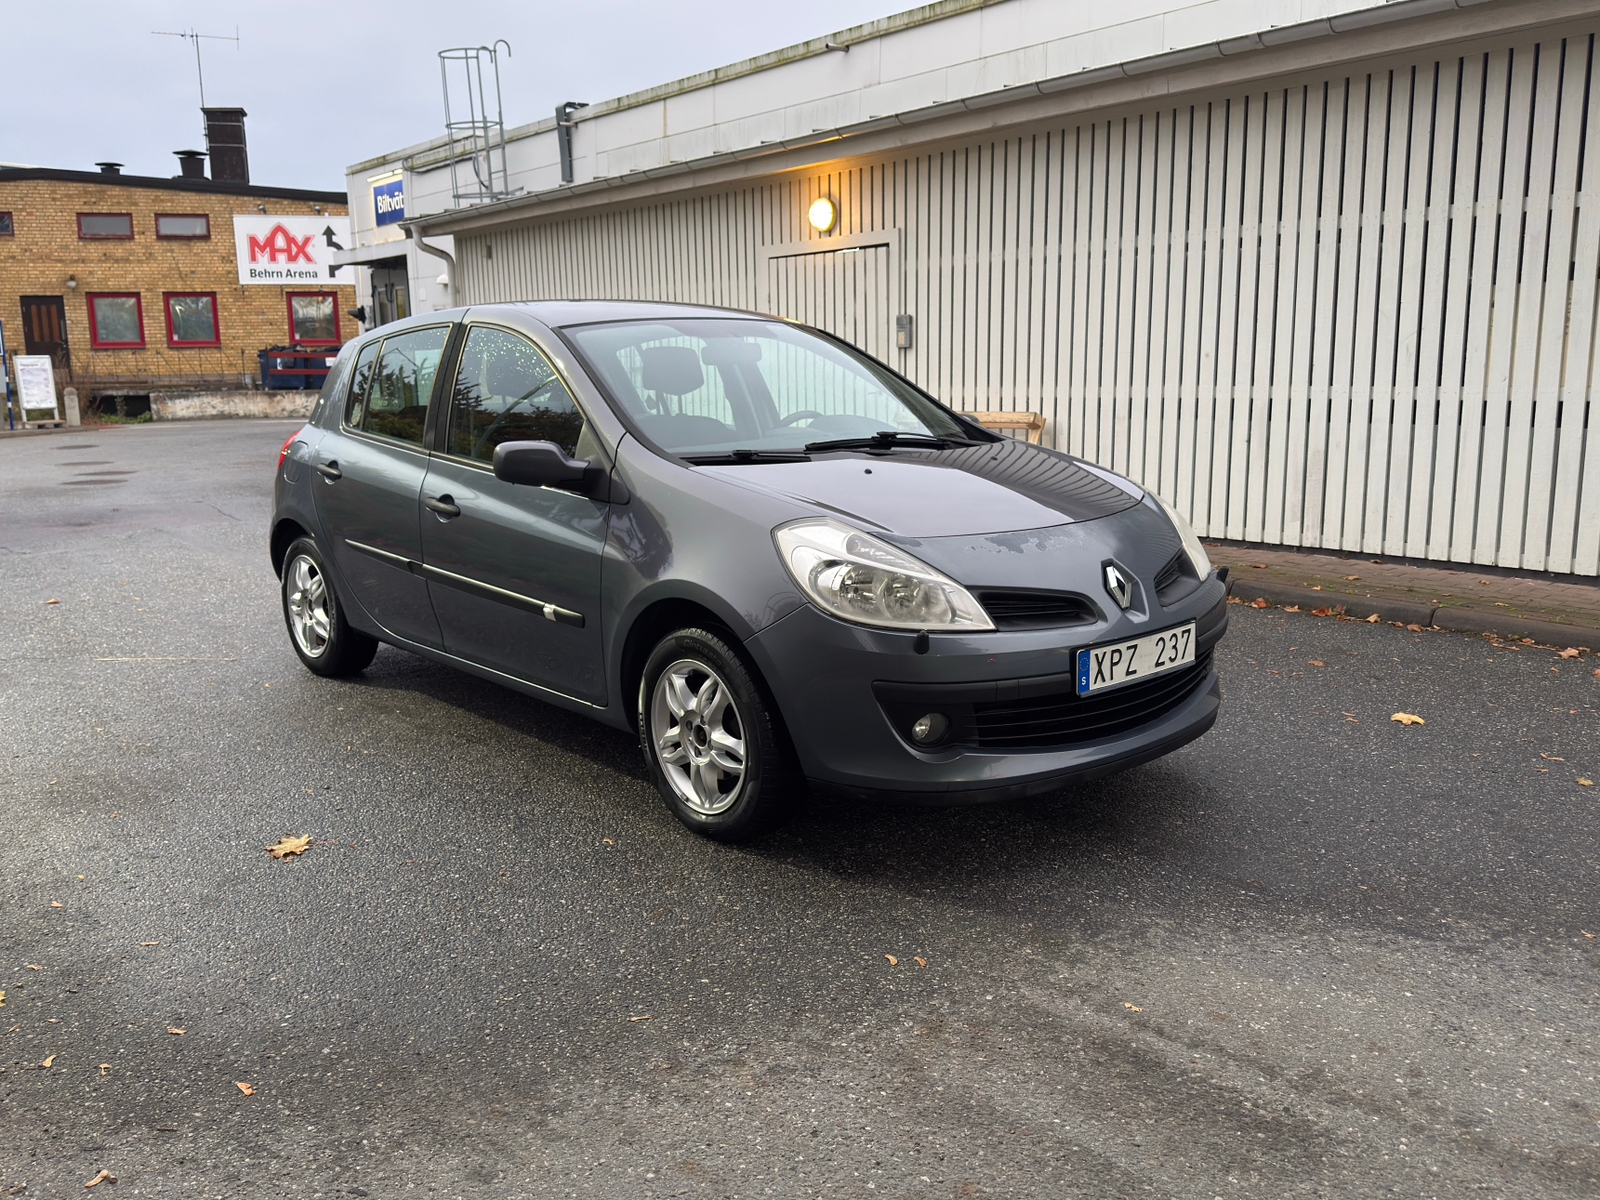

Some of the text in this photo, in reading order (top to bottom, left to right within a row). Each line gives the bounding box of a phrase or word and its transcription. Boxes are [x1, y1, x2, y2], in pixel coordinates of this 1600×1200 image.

[247, 222, 317, 264] MAX
[249, 268, 318, 279] Behrn Arena
[1093, 628, 1192, 685] XPZ 237
[1081, 676, 1087, 686] S
